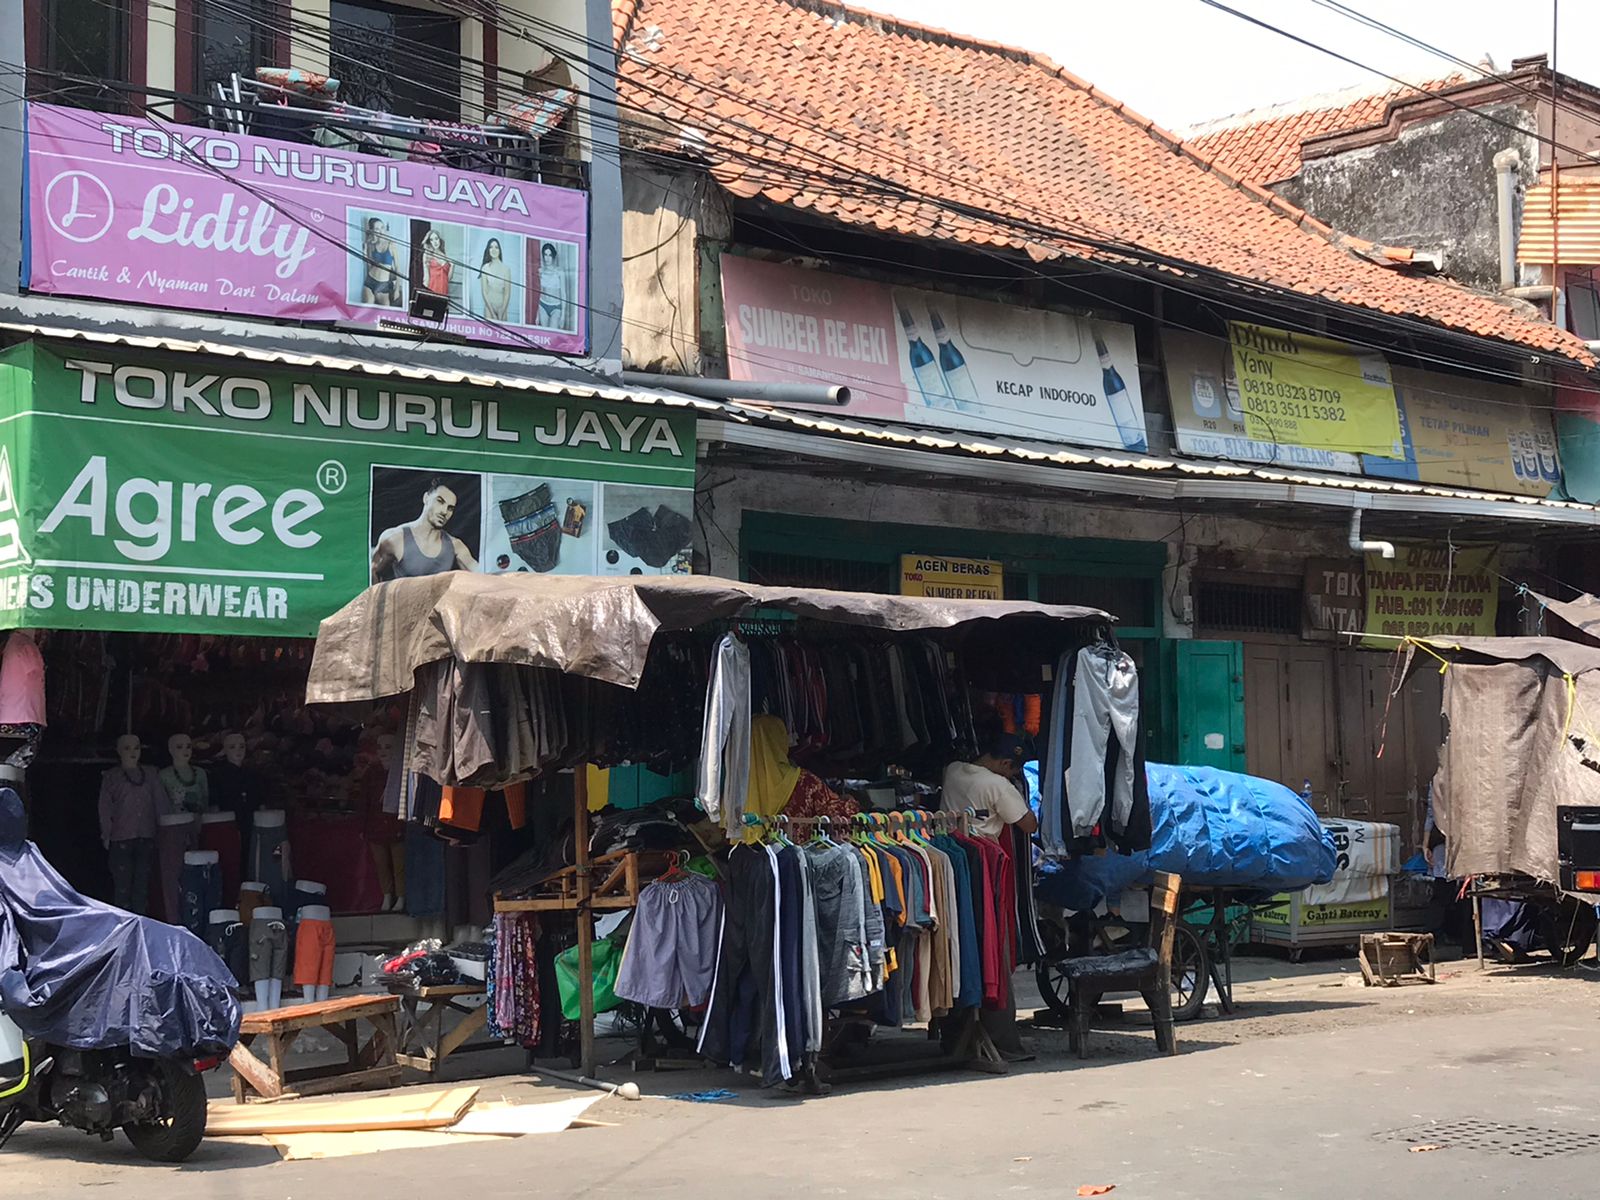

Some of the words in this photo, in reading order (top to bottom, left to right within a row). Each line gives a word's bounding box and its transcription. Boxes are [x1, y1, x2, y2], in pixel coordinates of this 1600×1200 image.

[102, 122, 240, 169] TOKO
[254, 144, 413, 196] NURUL
[422, 174, 530, 217] JAYA
[127, 183, 316, 278] Lidily
[50, 260, 109, 281] Cantik
[116, 266, 131, 283] &
[137, 270, 208, 293] Nyaman
[216, 278, 256, 298] Dari
[263, 284, 319, 304] Dalam
[792, 284, 832, 305] TOKO
[479, 327, 493, 336] NO
[739, 303, 821, 355] SUMBER
[824, 318, 888, 365] REJEKI
[1238, 350, 1273, 379] Yany
[996, 380, 1033, 397] KECAP
[1040, 386, 1096, 407] INDOFOOD
[1243, 378, 1275, 395] 0818
[1276, 384, 1307, 400] 0323
[1309, 388, 1341, 404] 8709
[65, 359, 272, 420] TOKO
[292, 382, 521, 443] NURUL
[534, 408, 682, 457] JAYA
[1247, 397, 1278, 414] 0813
[1280, 401, 1310, 419] 3511
[1313, 406, 1346, 422] 5382
[1223, 437, 1280, 462] BINTANG
[1288, 448, 1335, 467] TERANG
[37, 455, 324, 560] Agree
[904, 572, 923, 582] TOKO
[916, 559, 948, 573] AGEN
[952, 562, 990, 576] BERAS
[1367, 570, 1413, 591] TANPA
[66, 576, 289, 619] UNDERWEAR
[925, 585, 963, 599] SUMBER
[1306, 909, 1337, 921] Ganti
[1339, 908, 1382, 920] Bateray
